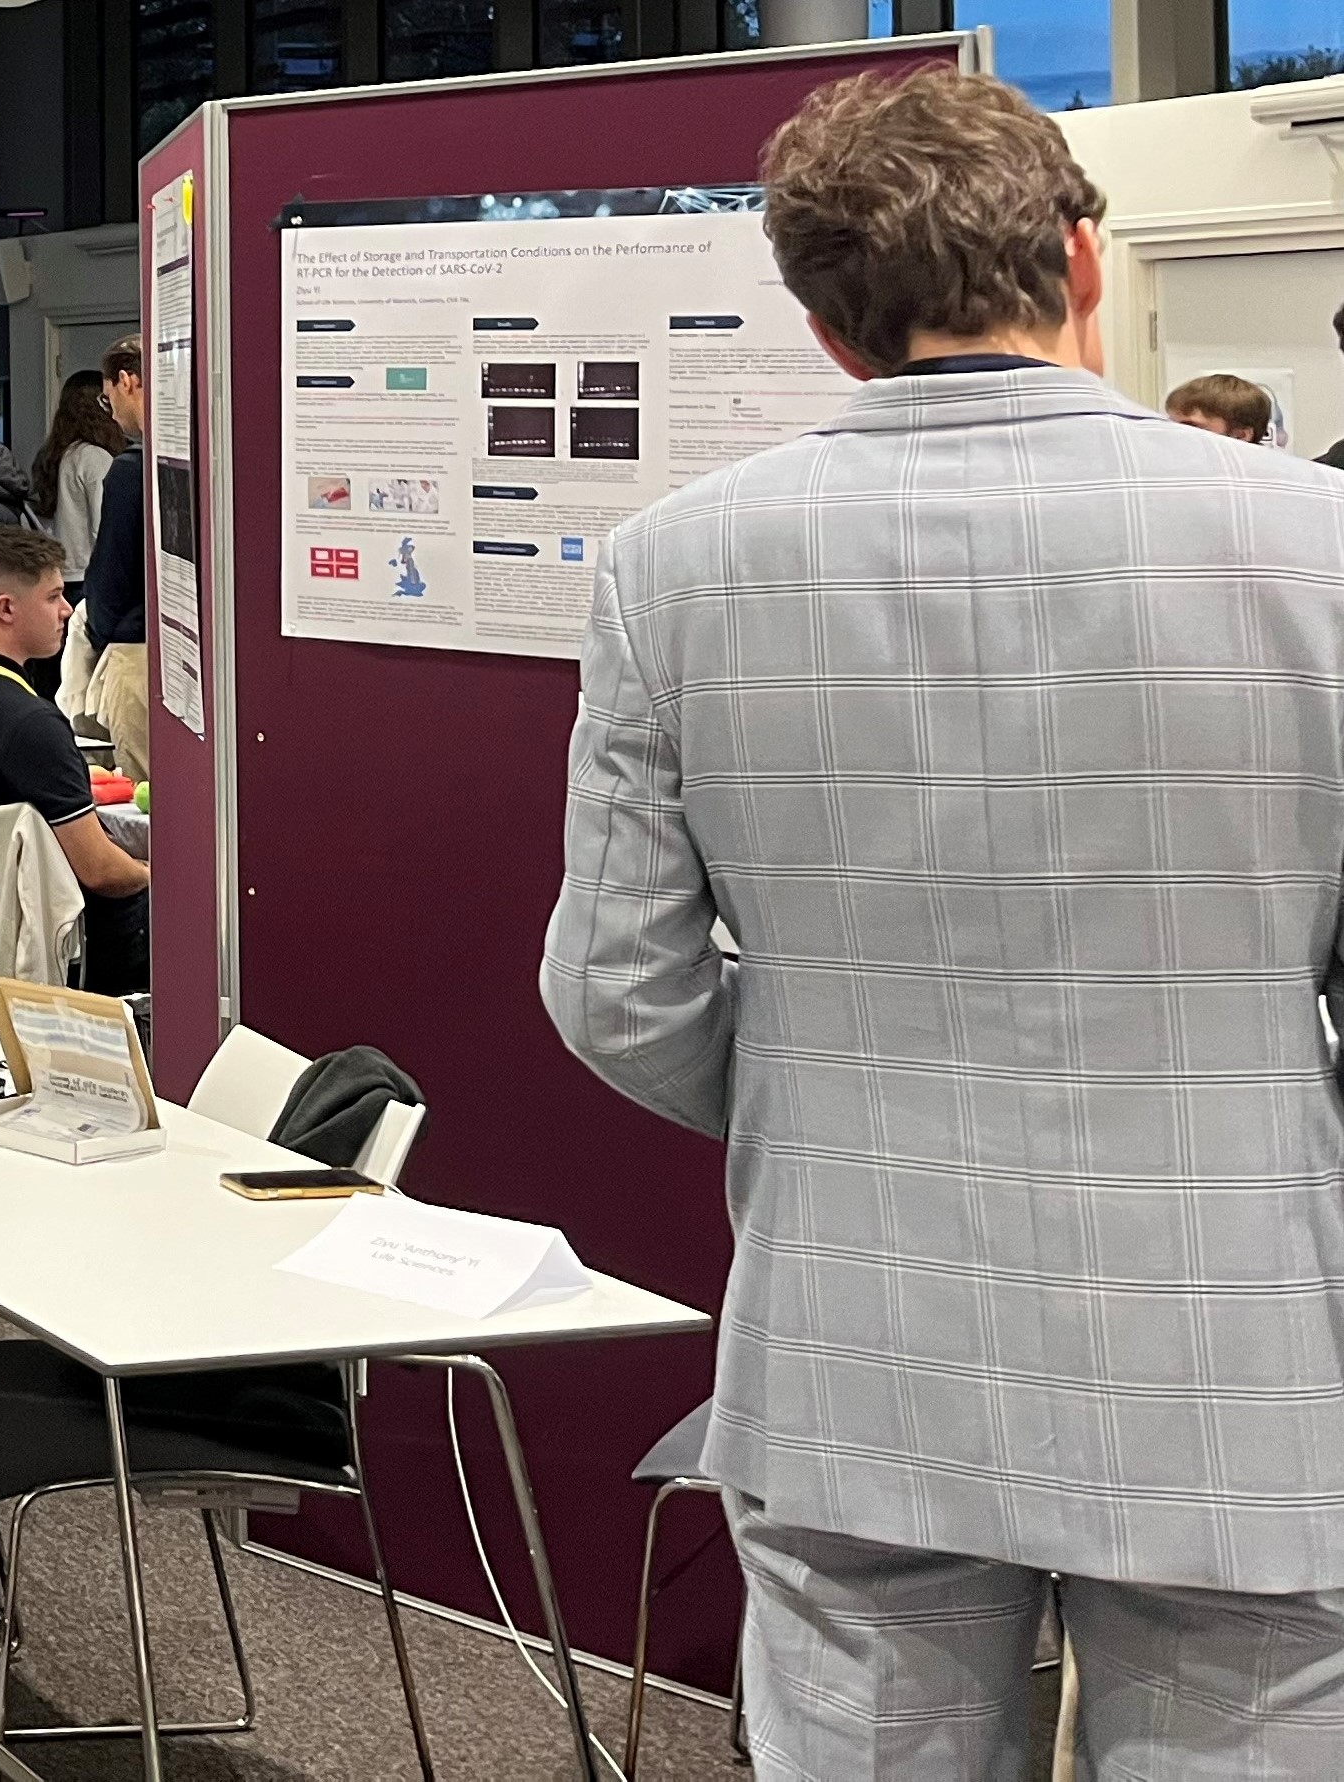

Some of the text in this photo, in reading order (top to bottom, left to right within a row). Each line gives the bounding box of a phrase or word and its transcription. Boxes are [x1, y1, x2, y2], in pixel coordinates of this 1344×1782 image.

[296, 241, 713, 265] The Effect of Storage and Transportation Conditions on the Performance of
[296, 262, 503, 279] RT-PCR for the Detection of SARS-CoV-2
